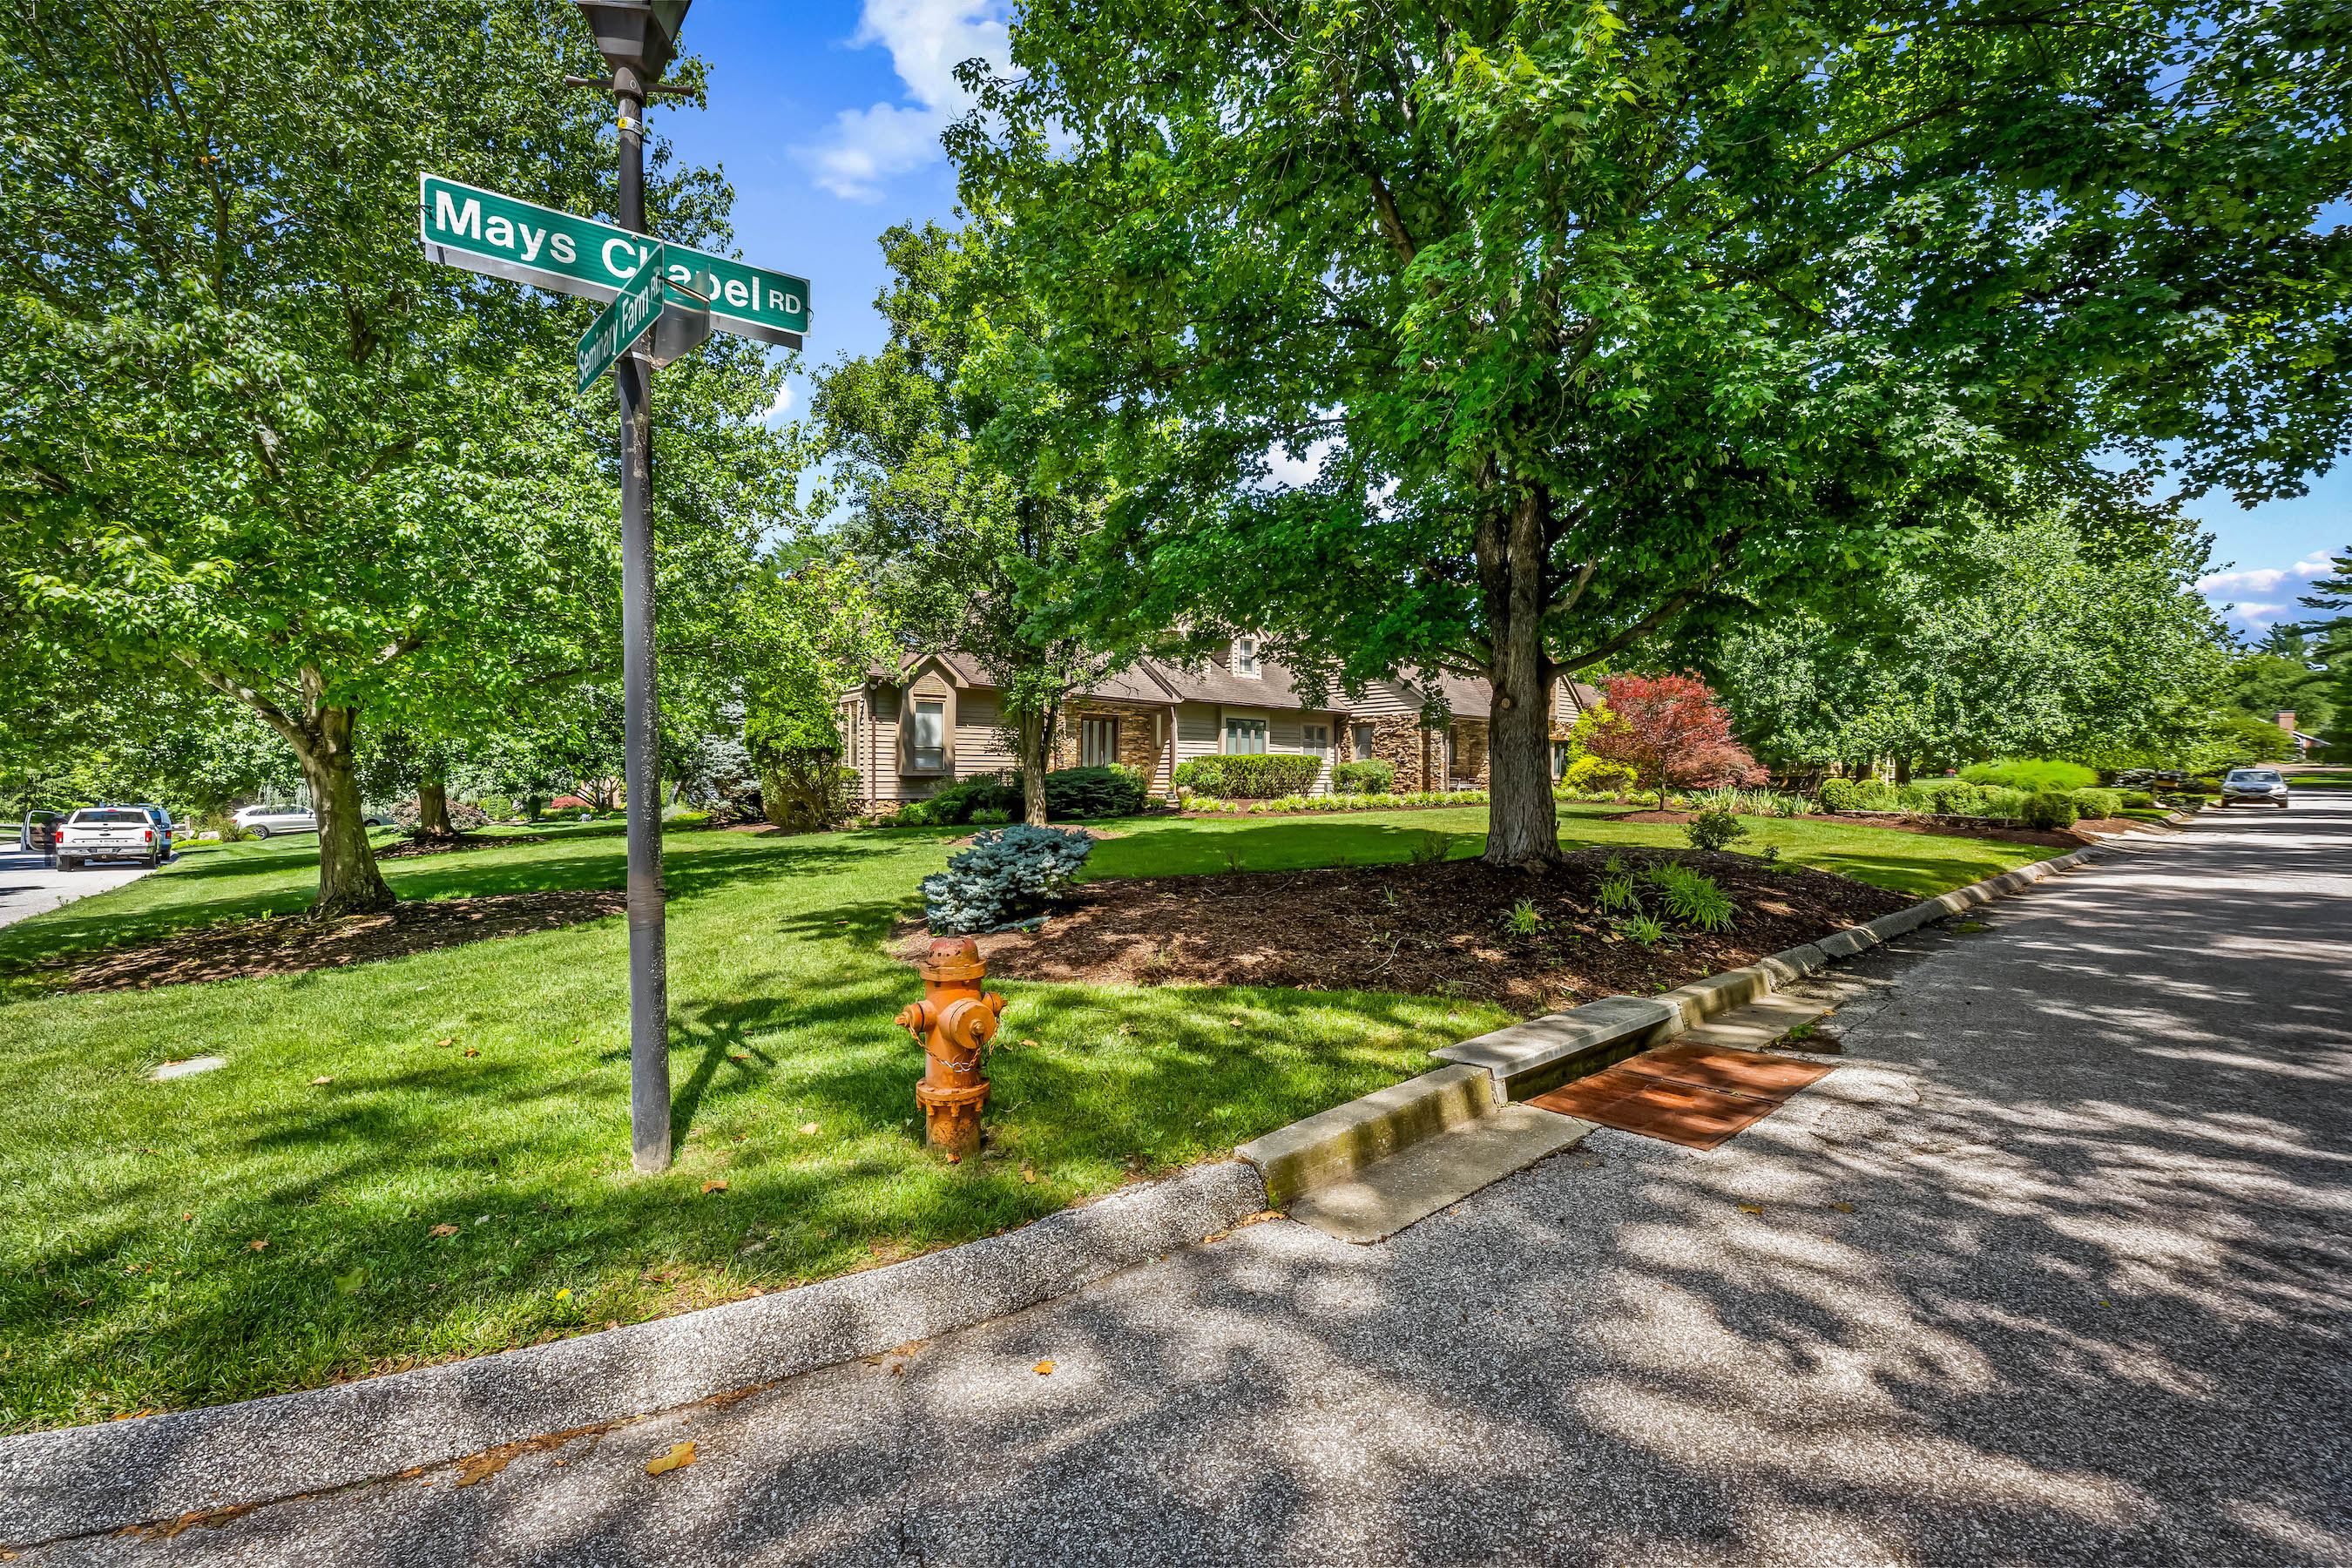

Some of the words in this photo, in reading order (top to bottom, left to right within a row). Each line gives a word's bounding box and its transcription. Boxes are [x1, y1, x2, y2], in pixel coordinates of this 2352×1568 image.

[436, 190, 577, 264] Mays
[768, 288, 801, 314] RD
[578, 319, 618, 383] Seminary
[622, 286, 649, 339] Farm
